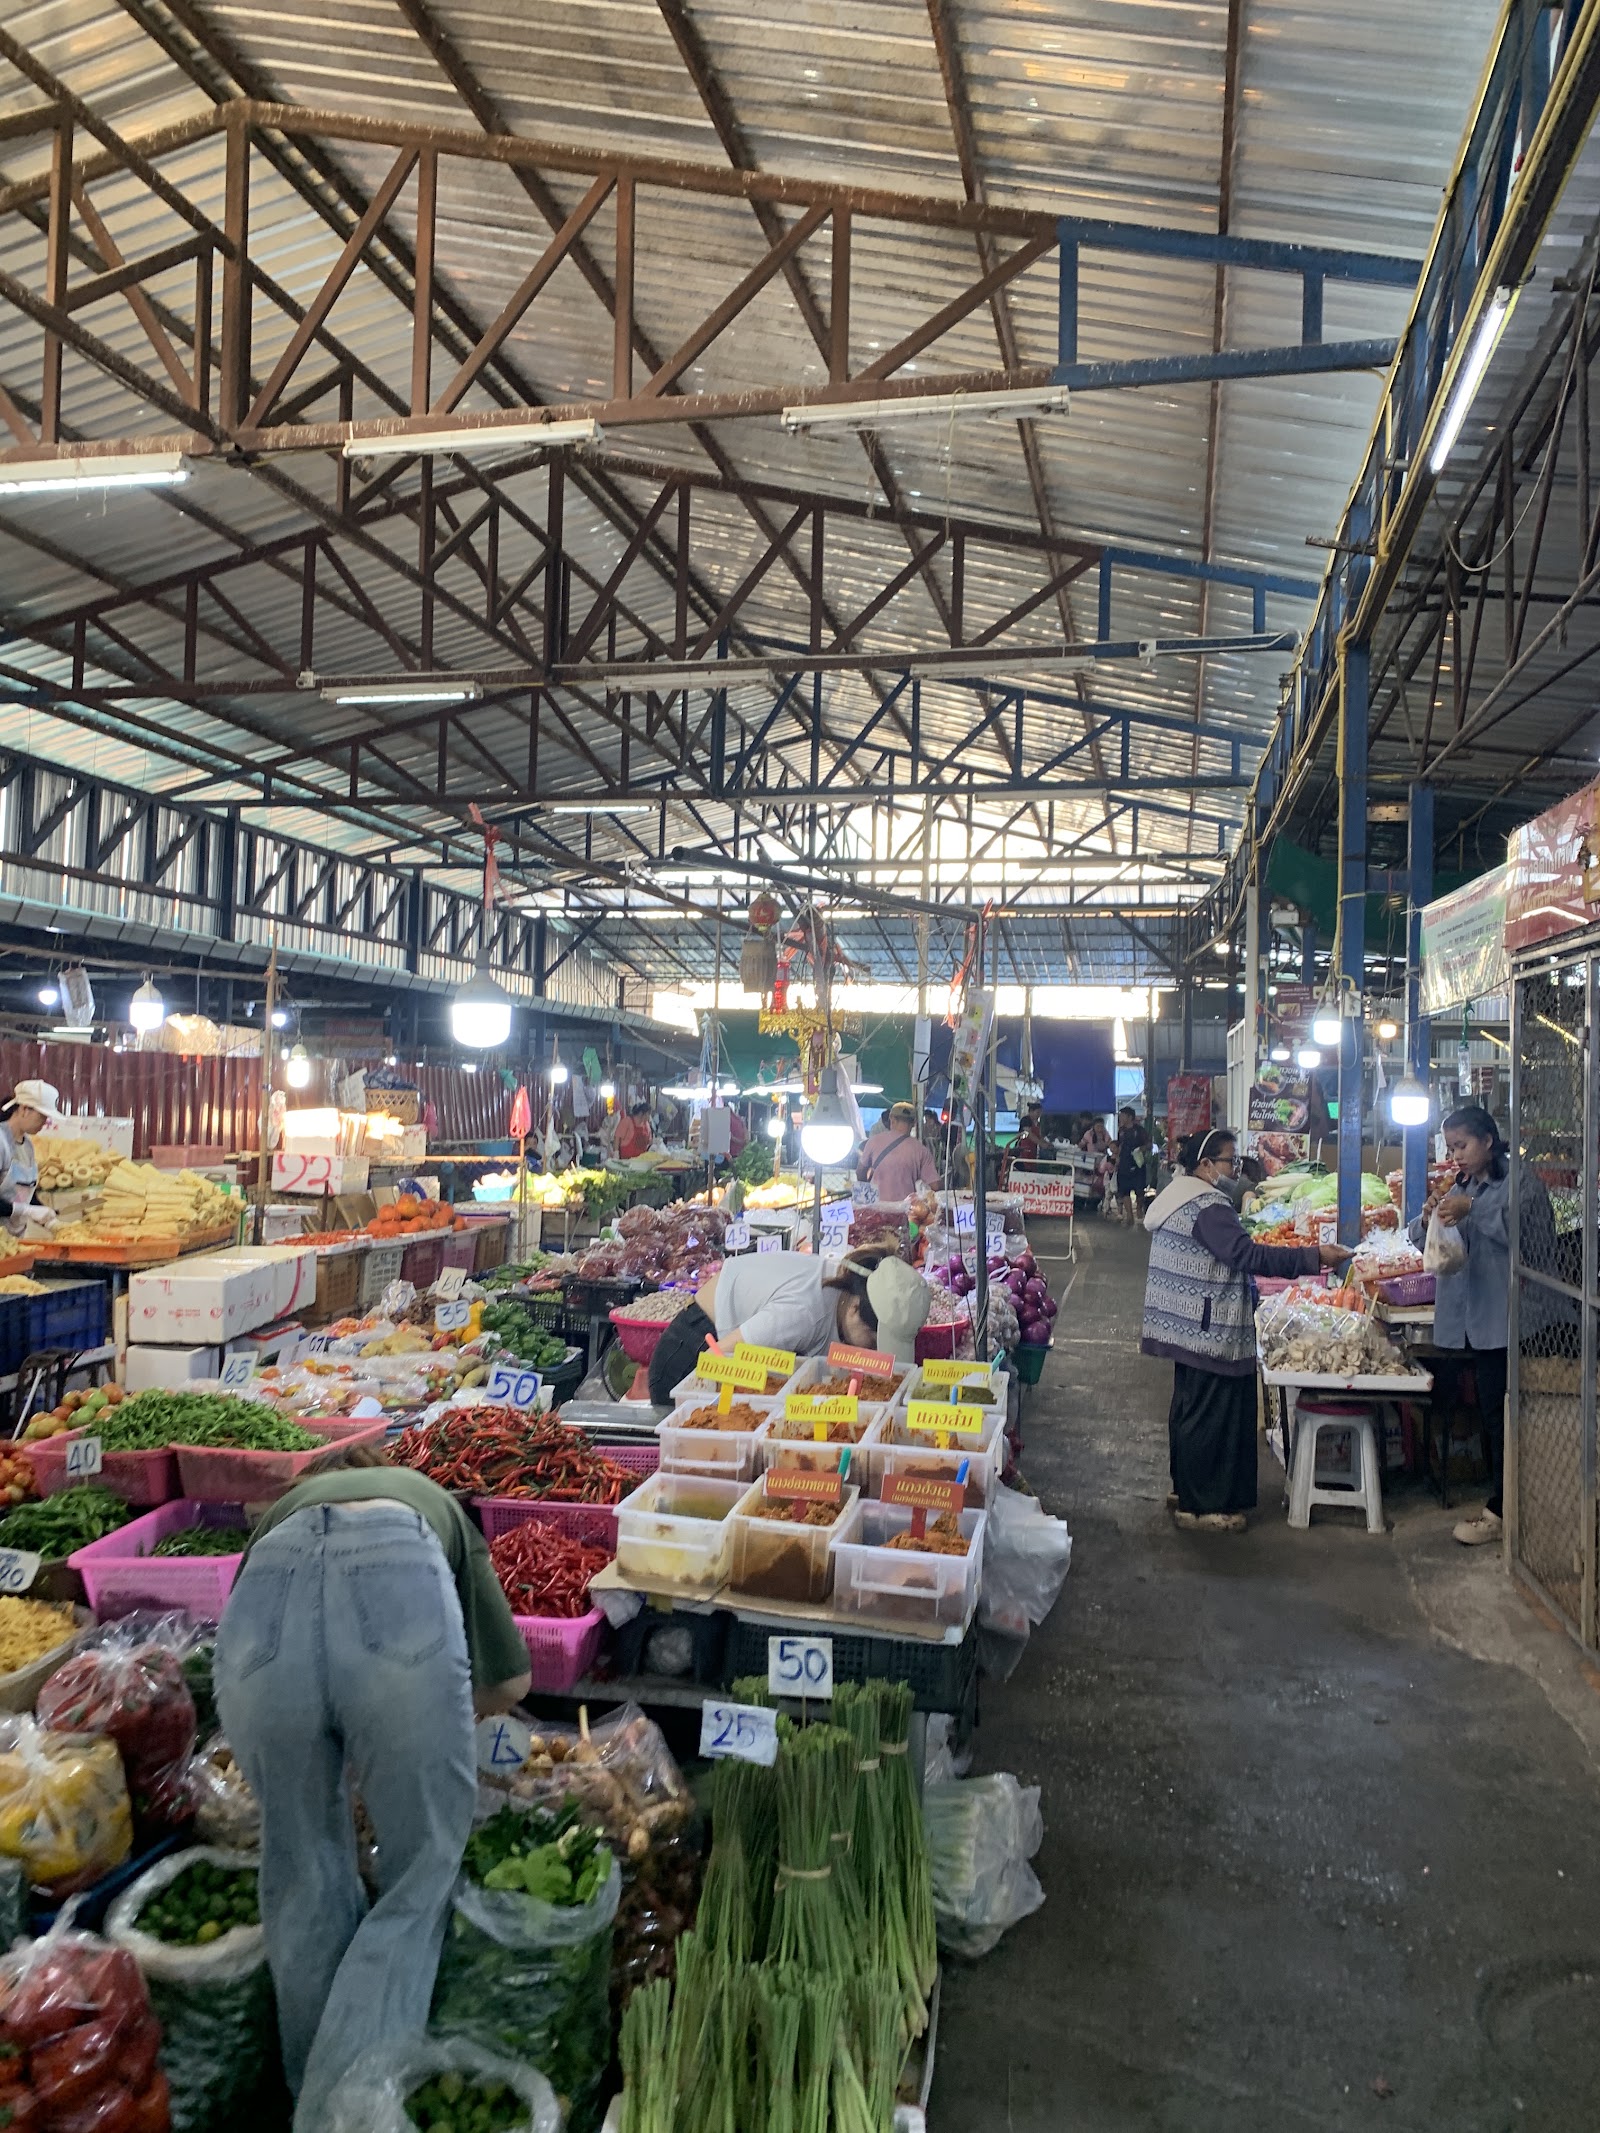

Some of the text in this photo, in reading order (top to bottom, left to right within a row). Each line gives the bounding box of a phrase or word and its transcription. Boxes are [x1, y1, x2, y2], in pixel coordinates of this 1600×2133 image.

[1009, 1180, 1074, 1197] แผงว่างให้เช่
[828, 1207, 849, 1222] 35
[726, 1227, 747, 1246] 45
[821, 1226, 847, 1246] 35
[1321, 1225, 1336, 1244] 30
[442, 1274, 463, 1294] 60
[438, 1302, 469, 1326] 35
[740, 1349, 791, 1371] แกงเผ็ด
[832, 1350, 891, 1371] แกงเผ็ดหยาบ
[223, 1358, 252, 1384] 65
[487, 1370, 539, 1406] 50
[916, 1409, 974, 1427] แกงส้ม
[69, 1441, 97, 1474] 40
[767, 1473, 839, 1493] แกงอ่อมหยาบ
[895, 1479, 952, 1498] แกงฮังเล
[778, 1639, 829, 1683] 50
[711, 1708, 757, 1747] 25
